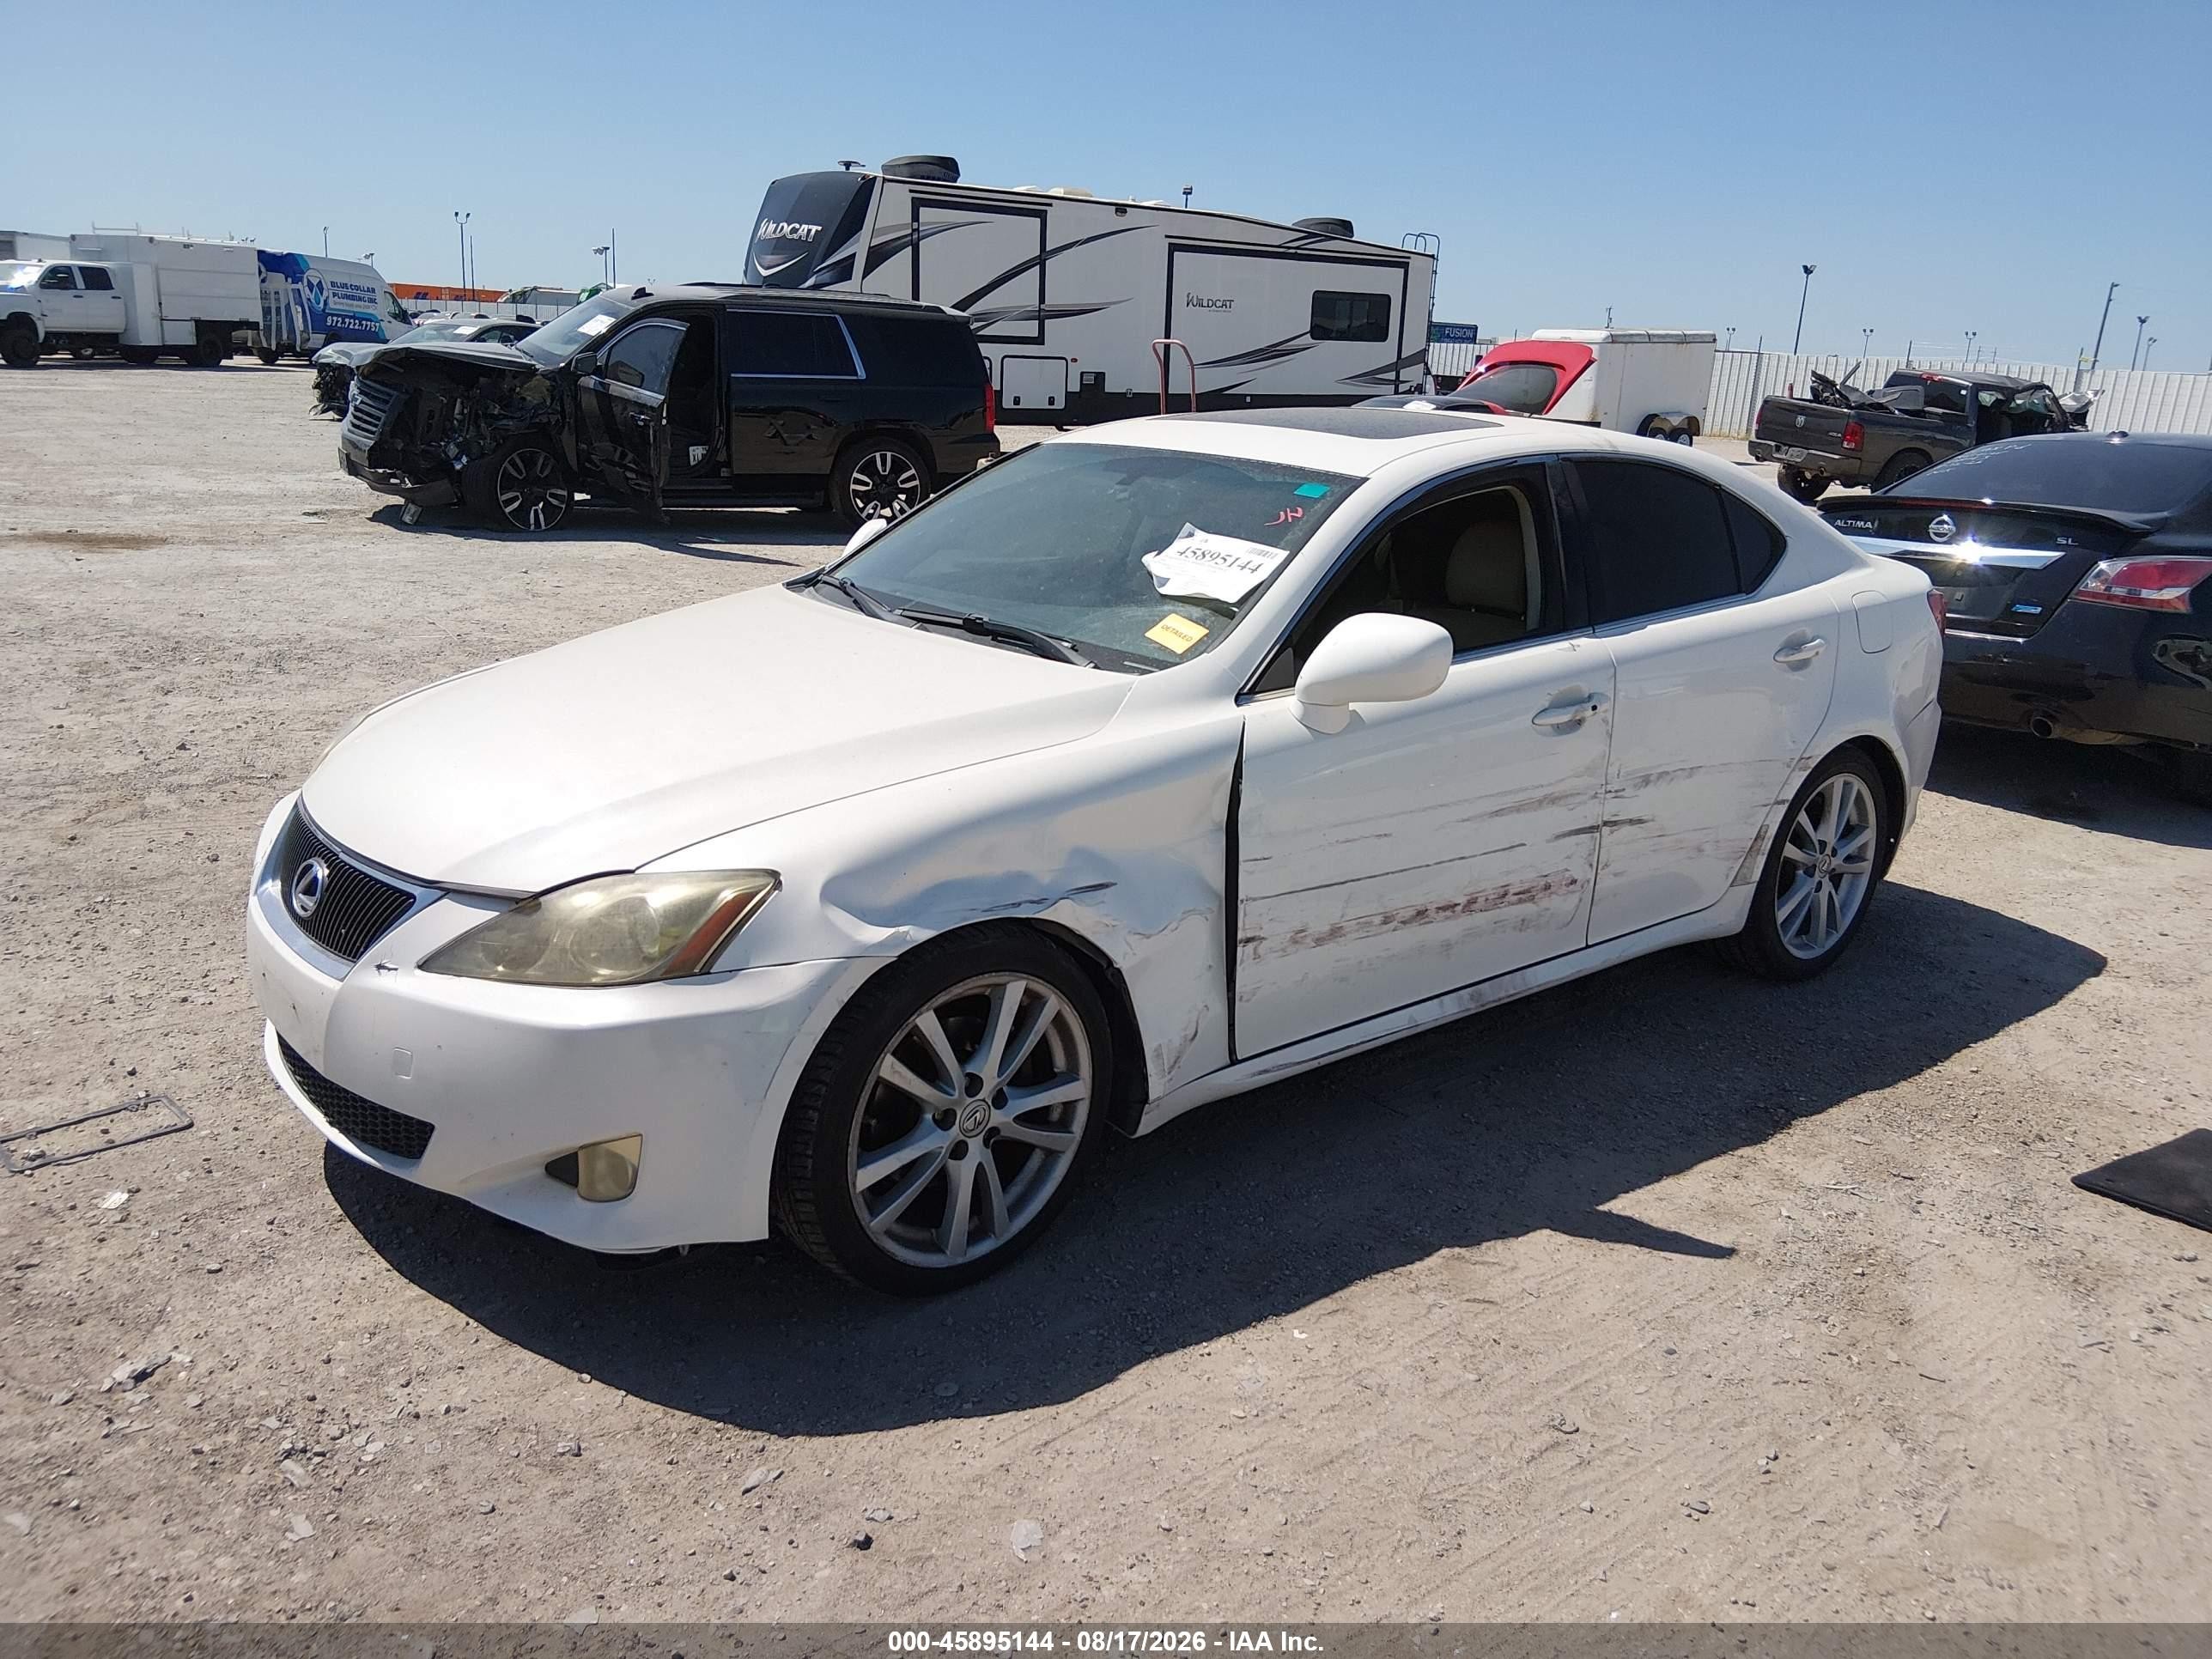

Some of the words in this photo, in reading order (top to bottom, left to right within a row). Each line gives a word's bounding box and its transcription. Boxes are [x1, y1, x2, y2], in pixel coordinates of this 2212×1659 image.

[755, 217, 822, 243] WILDCAT
[330, 281, 349, 290] BLUE
[349, 283, 376, 294] COLLAR
[1186, 292, 1235, 309] WILDCAT
[326, 315, 380, 332] 972.722.7757
[1444, 327, 1474, 338] FUSION
[1834, 519, 1873, 529] ALTIMA
[2056, 537, 2079, 545] SL
[1176, 546, 1265, 574] 45895144
[1160, 624, 1194, 642] DETAILED
